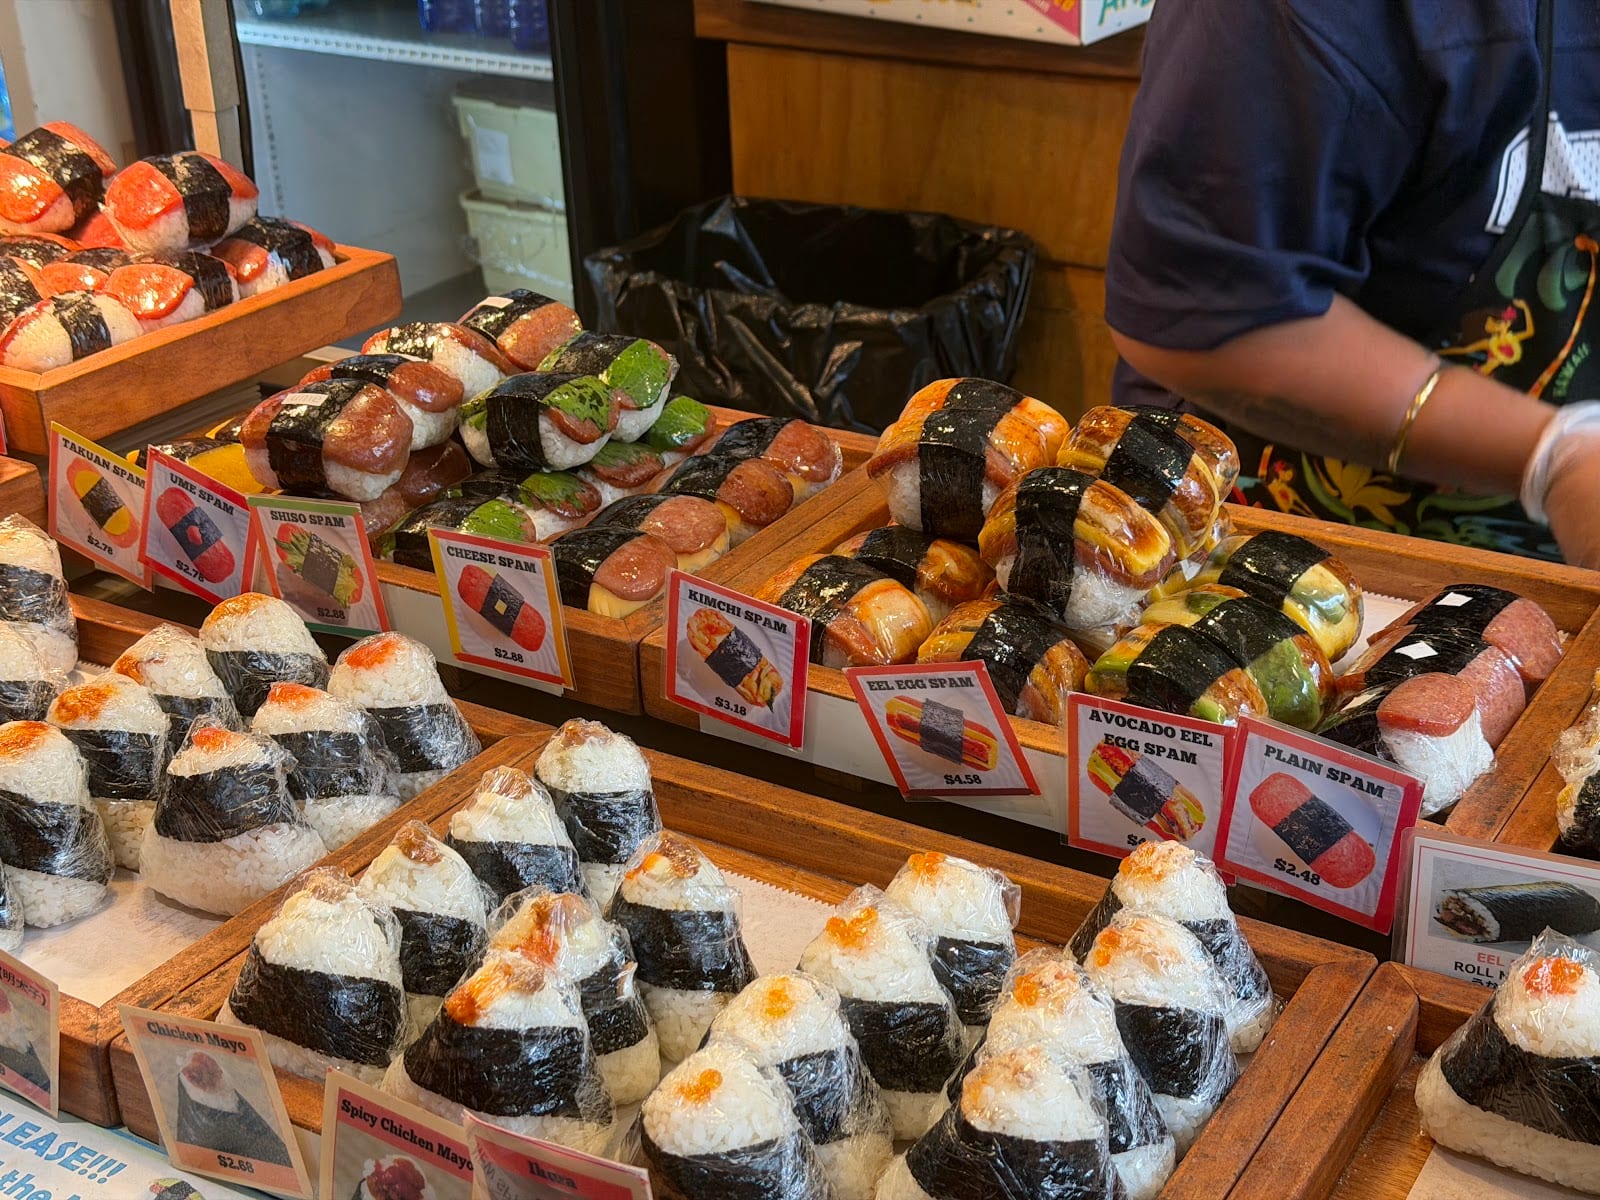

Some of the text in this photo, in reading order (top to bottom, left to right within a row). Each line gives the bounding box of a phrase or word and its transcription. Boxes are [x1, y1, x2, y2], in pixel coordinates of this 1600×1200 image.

[62, 437, 146, 490] TAKUAN SPAM
[170, 473, 235, 516] UME SPAM
[270, 510, 345, 528] SHISO SPAM
[87, 535, 114, 556] $2.78
[446, 545, 537, 574] CHEESE SPAM
[317, 607, 346, 620] $2.88
[688, 589, 788, 635] KIMCHI SPAM
[494, 647, 524, 663] $2.88
[866, 676, 975, 691] EEL EGG SPAM
[714, 696, 747, 717] $3.18
[1088, 709, 1213, 747] AVOCADO EEL
[1104, 733, 1198, 765] EGG SPAM
[944, 774, 982, 785] $4.58
[1264, 744, 1385, 799] PLAIN SPAM
[1273, 857, 1321, 886] $2.48
[1454, 961, 1495, 978] ROLL
[1477, 952, 1505, 967] EEL
[147, 1021, 247, 1053] Chicken Mayo
[0, 1111, 128, 1184] LEASE!!!
[341, 1098, 474, 1171] Spicy Chicken Mayo
[217, 1154, 255, 1174] $2.68
